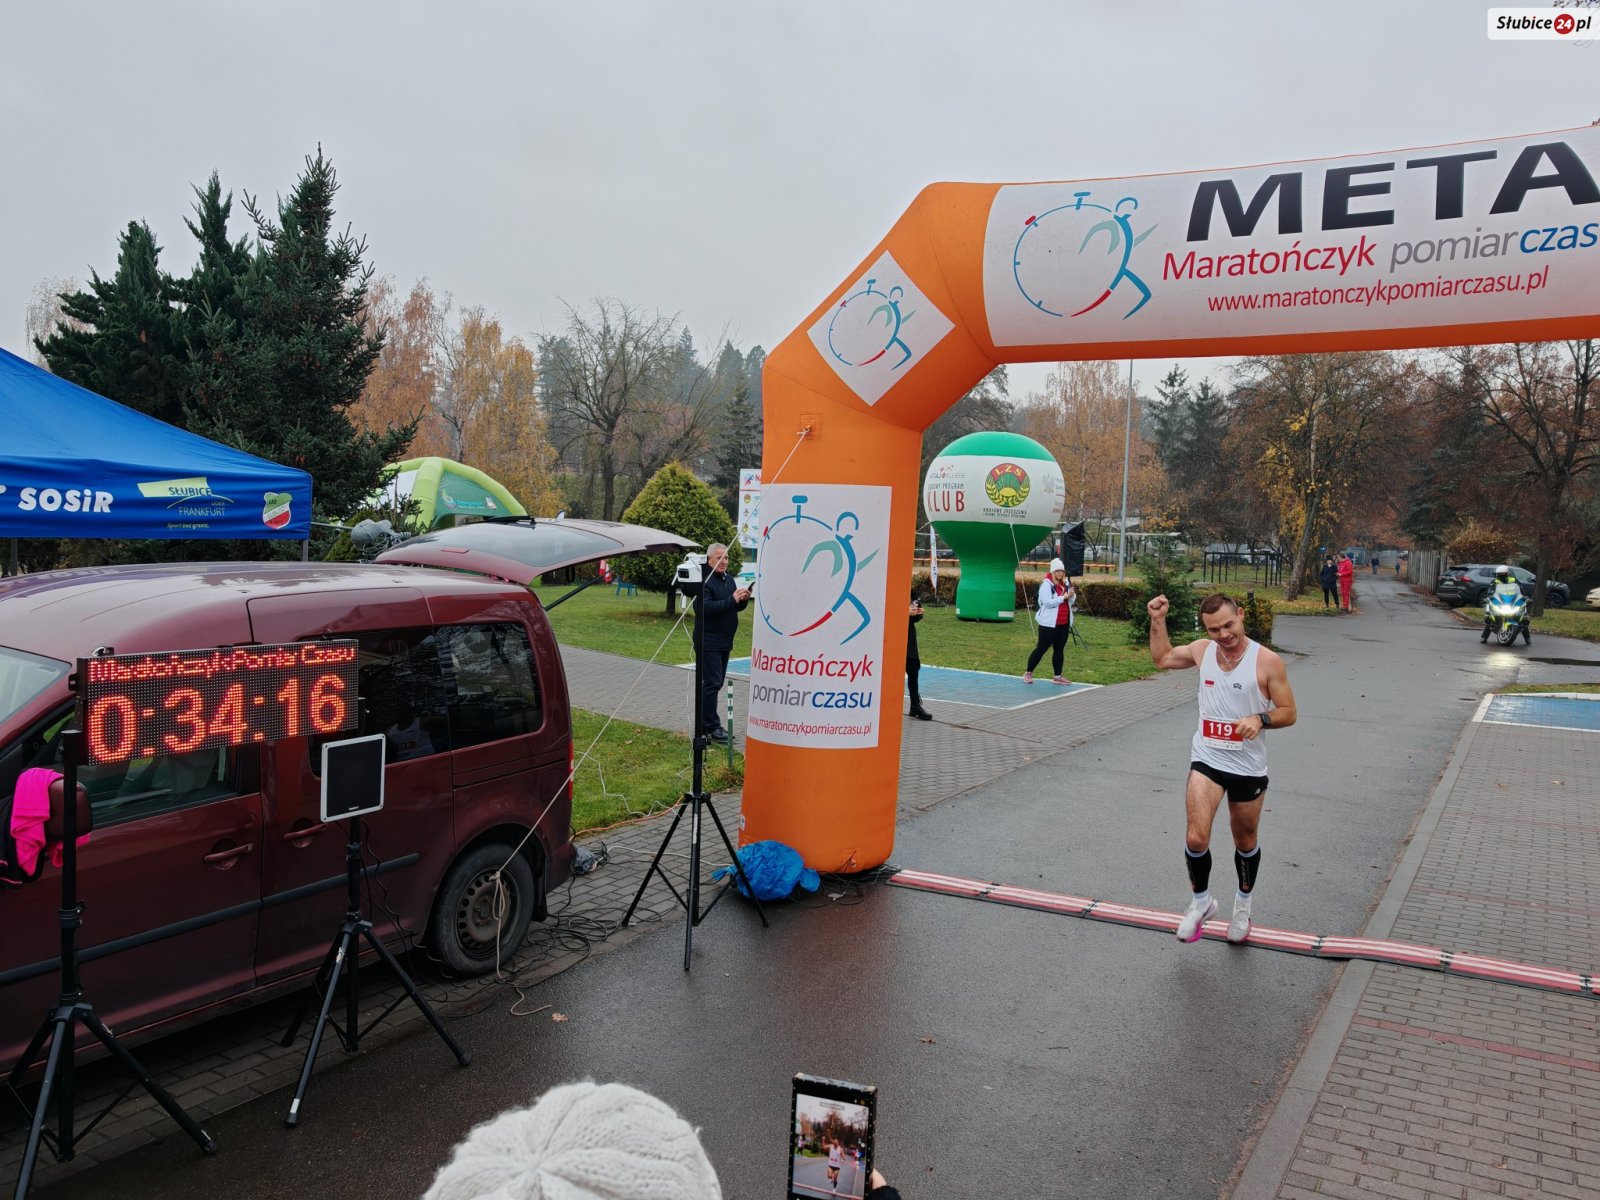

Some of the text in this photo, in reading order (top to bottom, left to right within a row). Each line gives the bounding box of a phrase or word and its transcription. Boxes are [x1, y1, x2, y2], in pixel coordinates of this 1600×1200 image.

[1186, 141, 1600, 242] META
[1162, 234, 1377, 281] Maratończyk
[1207, 264, 1550, 312] www.maratonczykpomiarczasu.pl
[18, 487, 114, 513] SOSiR
[168, 486, 212, 497] SŁUBICE
[927, 490, 965, 513] KLUB
[178, 506, 226, 517] FRANKFURT
[752, 647, 874, 683] Maratończyk
[88, 673, 346, 763] 0:34:16
[749, 715, 872, 736] www.maratonczykpomiarczasu.pl
[1209, 722, 1233, 736] 119
